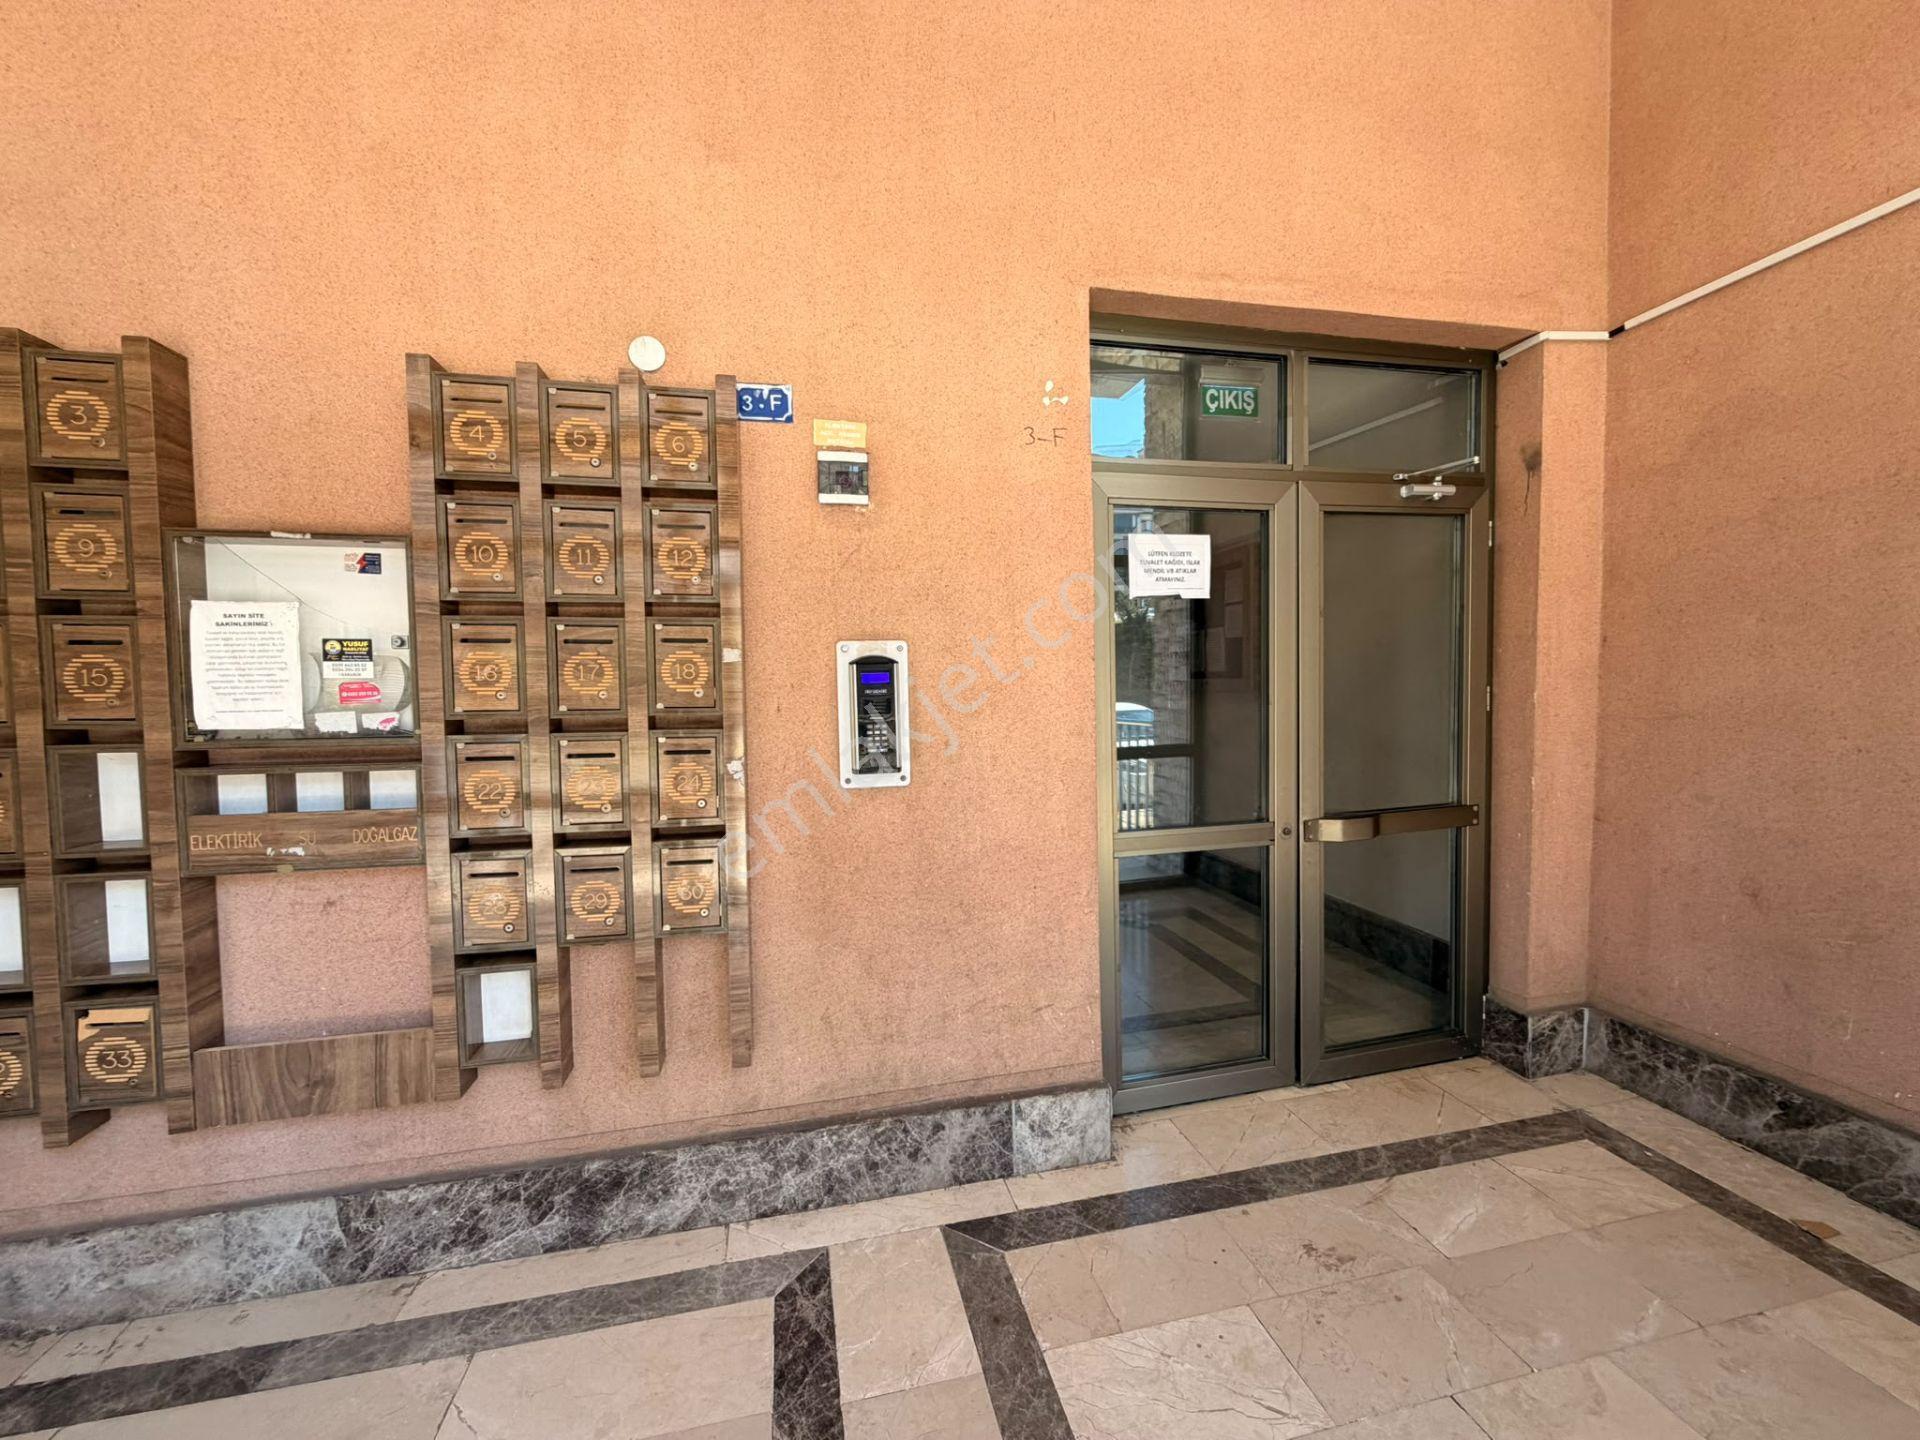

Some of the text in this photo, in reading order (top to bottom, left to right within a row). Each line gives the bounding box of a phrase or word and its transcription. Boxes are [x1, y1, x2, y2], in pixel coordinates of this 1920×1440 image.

[1206, 388, 1255, 415] ÇIKIŞ
[69, 404, 88, 425] 3
[469, 424, 485, 442] 4
[572, 430, 587, 448] 5
[672, 436, 686, 453] 6
[78, 538, 95, 558] 9
[471, 545, 494, 563] 10
[577, 549, 591, 566] 11
[672, 549, 693, 566] 12
[80, 668, 109, 688] 15
[474, 664, 498, 681] 16
[578, 664, 600, 681] 17
[673, 663, 696, 680] 18
[478, 783, 502, 800] 22
[677, 775, 699, 791] 24
[190, 832, 262, 850] ELEKTİRİK
[299, 832, 317, 846] SU
[584, 893, 607, 909] 29
[101, 1049, 132, 1069] 33
